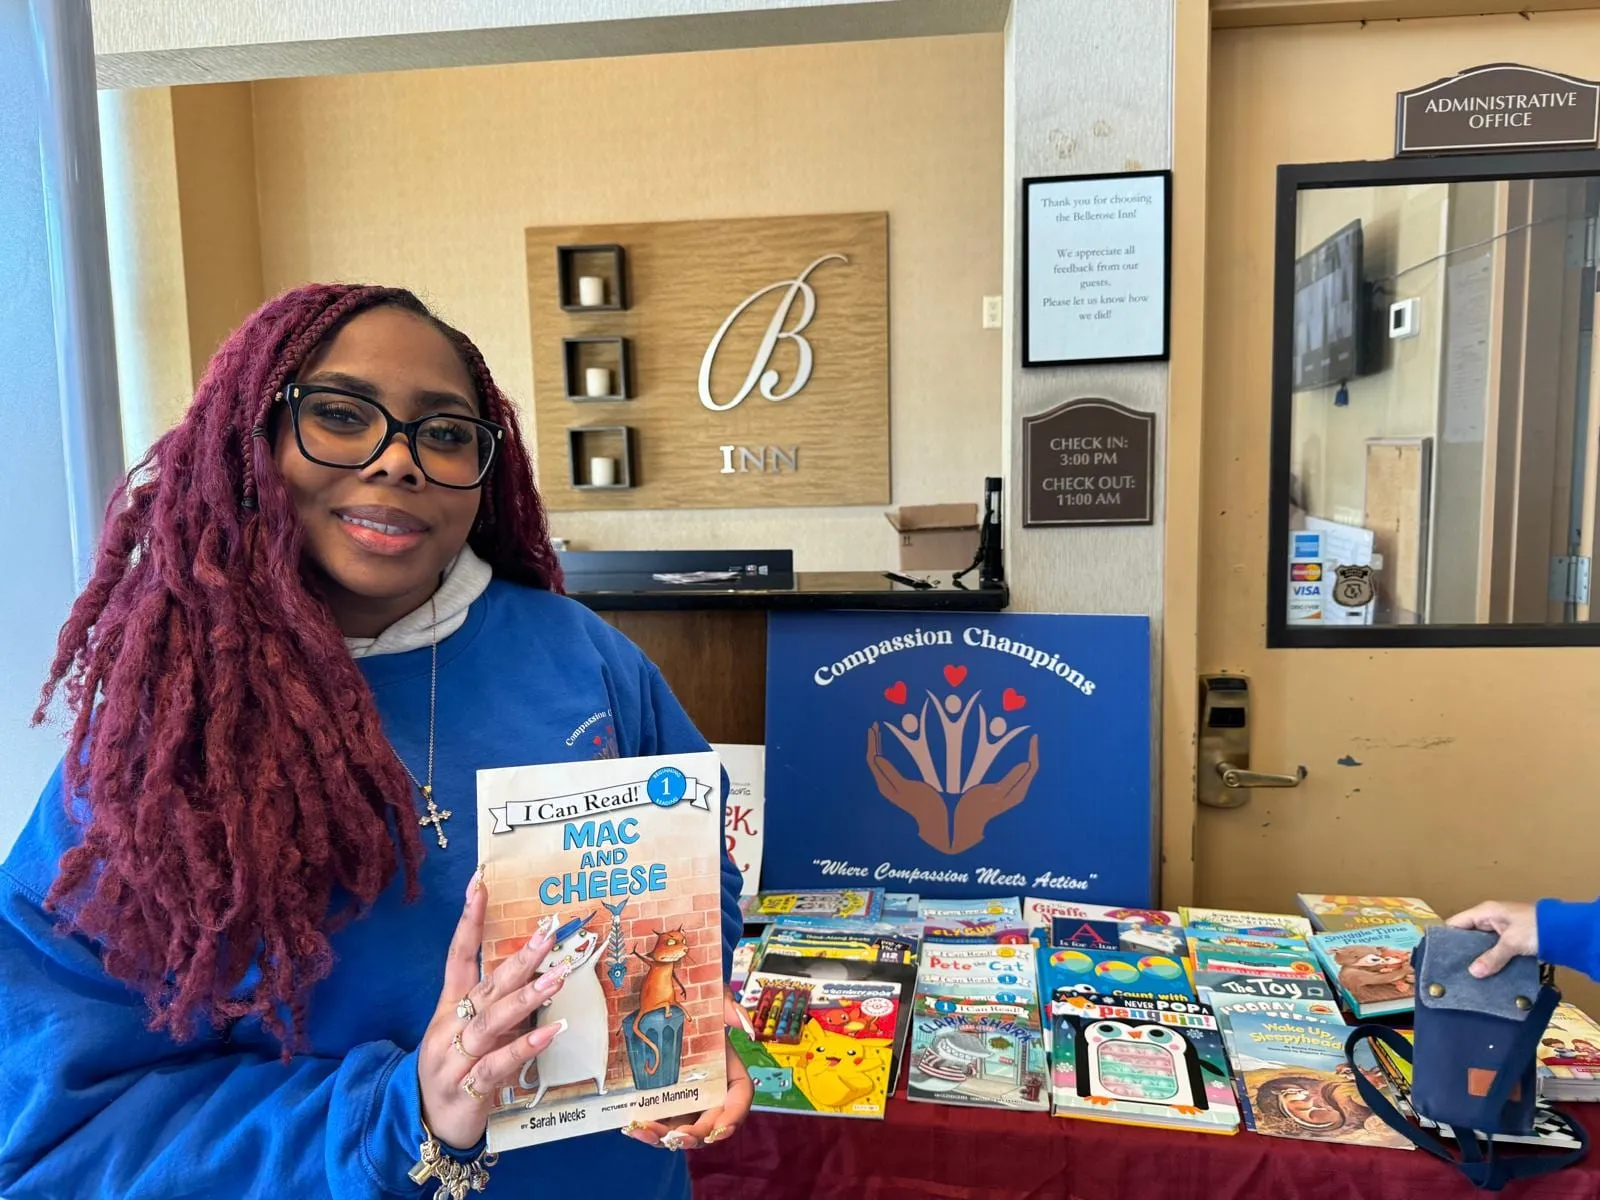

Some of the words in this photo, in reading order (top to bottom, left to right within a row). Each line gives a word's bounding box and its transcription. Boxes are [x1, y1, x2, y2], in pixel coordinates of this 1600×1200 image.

[1424, 92, 1577, 113] ADMINISTRATIVE
[1468, 112, 1532, 129] OFFICE
[1041, 198, 1071, 208] Thank
[1073, 198, 1091, 208] you
[1093, 194, 1107, 204] for
[1109, 193, 1152, 205] choosing
[1056, 213, 1070, 222] the
[1073, 210, 1115, 221] Bellerose
[1117, 209, 1137, 219] Inn!
[1057, 249, 1073, 258] We
[1075, 248, 1122, 260] appreciate
[1124, 246, 1135, 256] all
[1053, 263, 1094, 274] feedback
[1097, 262, 1120, 272] from
[1122, 262, 1139, 270] our
[1079, 280, 1111, 289] guests.
[1043, 298, 1071, 307] Please
[1073, 296, 1084, 305] let
[1100, 295, 1125, 304] know
[1128, 294, 1149, 303] how
[1094, 310, 1112, 319] did!
[698, 253, 849, 411] B
[1050, 437, 1103, 450] CHECK
[1107, 436, 1129, 449] IN:
[719, 445, 798, 474] INN
[1060, 453, 1090, 466] 3:00
[1094, 452, 1118, 465] PM
[1042, 477, 1095, 491] CHECK
[1098, 476, 1136, 489] OUT:
[1057, 493, 1092, 506] 11:00
[1095, 492, 1121, 505] AM
[1293, 586, 1321, 596] VISA
[814, 628, 953, 686] Compassion
[962, 627, 1096, 696] Champions
[565, 711, 607, 746] Compassion
[661, 777, 671, 796] 1
[523, 805, 531, 821] I
[538, 802, 579, 820] Can
[583, 787, 639, 812] Read!
[563, 817, 641, 850] MAC
[580, 847, 628, 869] AND
[874, 862, 969, 883] Compassion
[975, 867, 1027, 887] Meets
[539, 863, 668, 905] CHEESE
[1032, 902, 1088, 918] Giraffe
[963, 924, 997, 936] GUY
[1067, 923, 1110, 944] A
[1324, 930, 1372, 943] Snuggle
[1372, 926, 1408, 935] Time
[1071, 940, 1087, 948] for
[1344, 935, 1391, 945] Prayers
[929, 955, 972, 971] Pete
[988, 961, 1024, 972] Cat
[1112, 990, 1154, 999] Count
[1158, 993, 1189, 1002] with
[1221, 981, 1256, 994] The
[1247, 978, 1303, 999] Toy
[1124, 1000, 1154, 1010] NEVER
[1156, 1000, 1200, 1014] POP
[919, 1015, 969, 1034] CLARK
[980, 1016, 1033, 1043] SHARK
[1262, 1023, 1304, 1033] Wake
[601, 1103, 629, 1113] PICTURES
[638, 1095, 660, 1108] Jane
[662, 1087, 699, 1103] Manning
[530, 1115, 557, 1130] Sarah
[558, 1108, 586, 1126] Weeks
